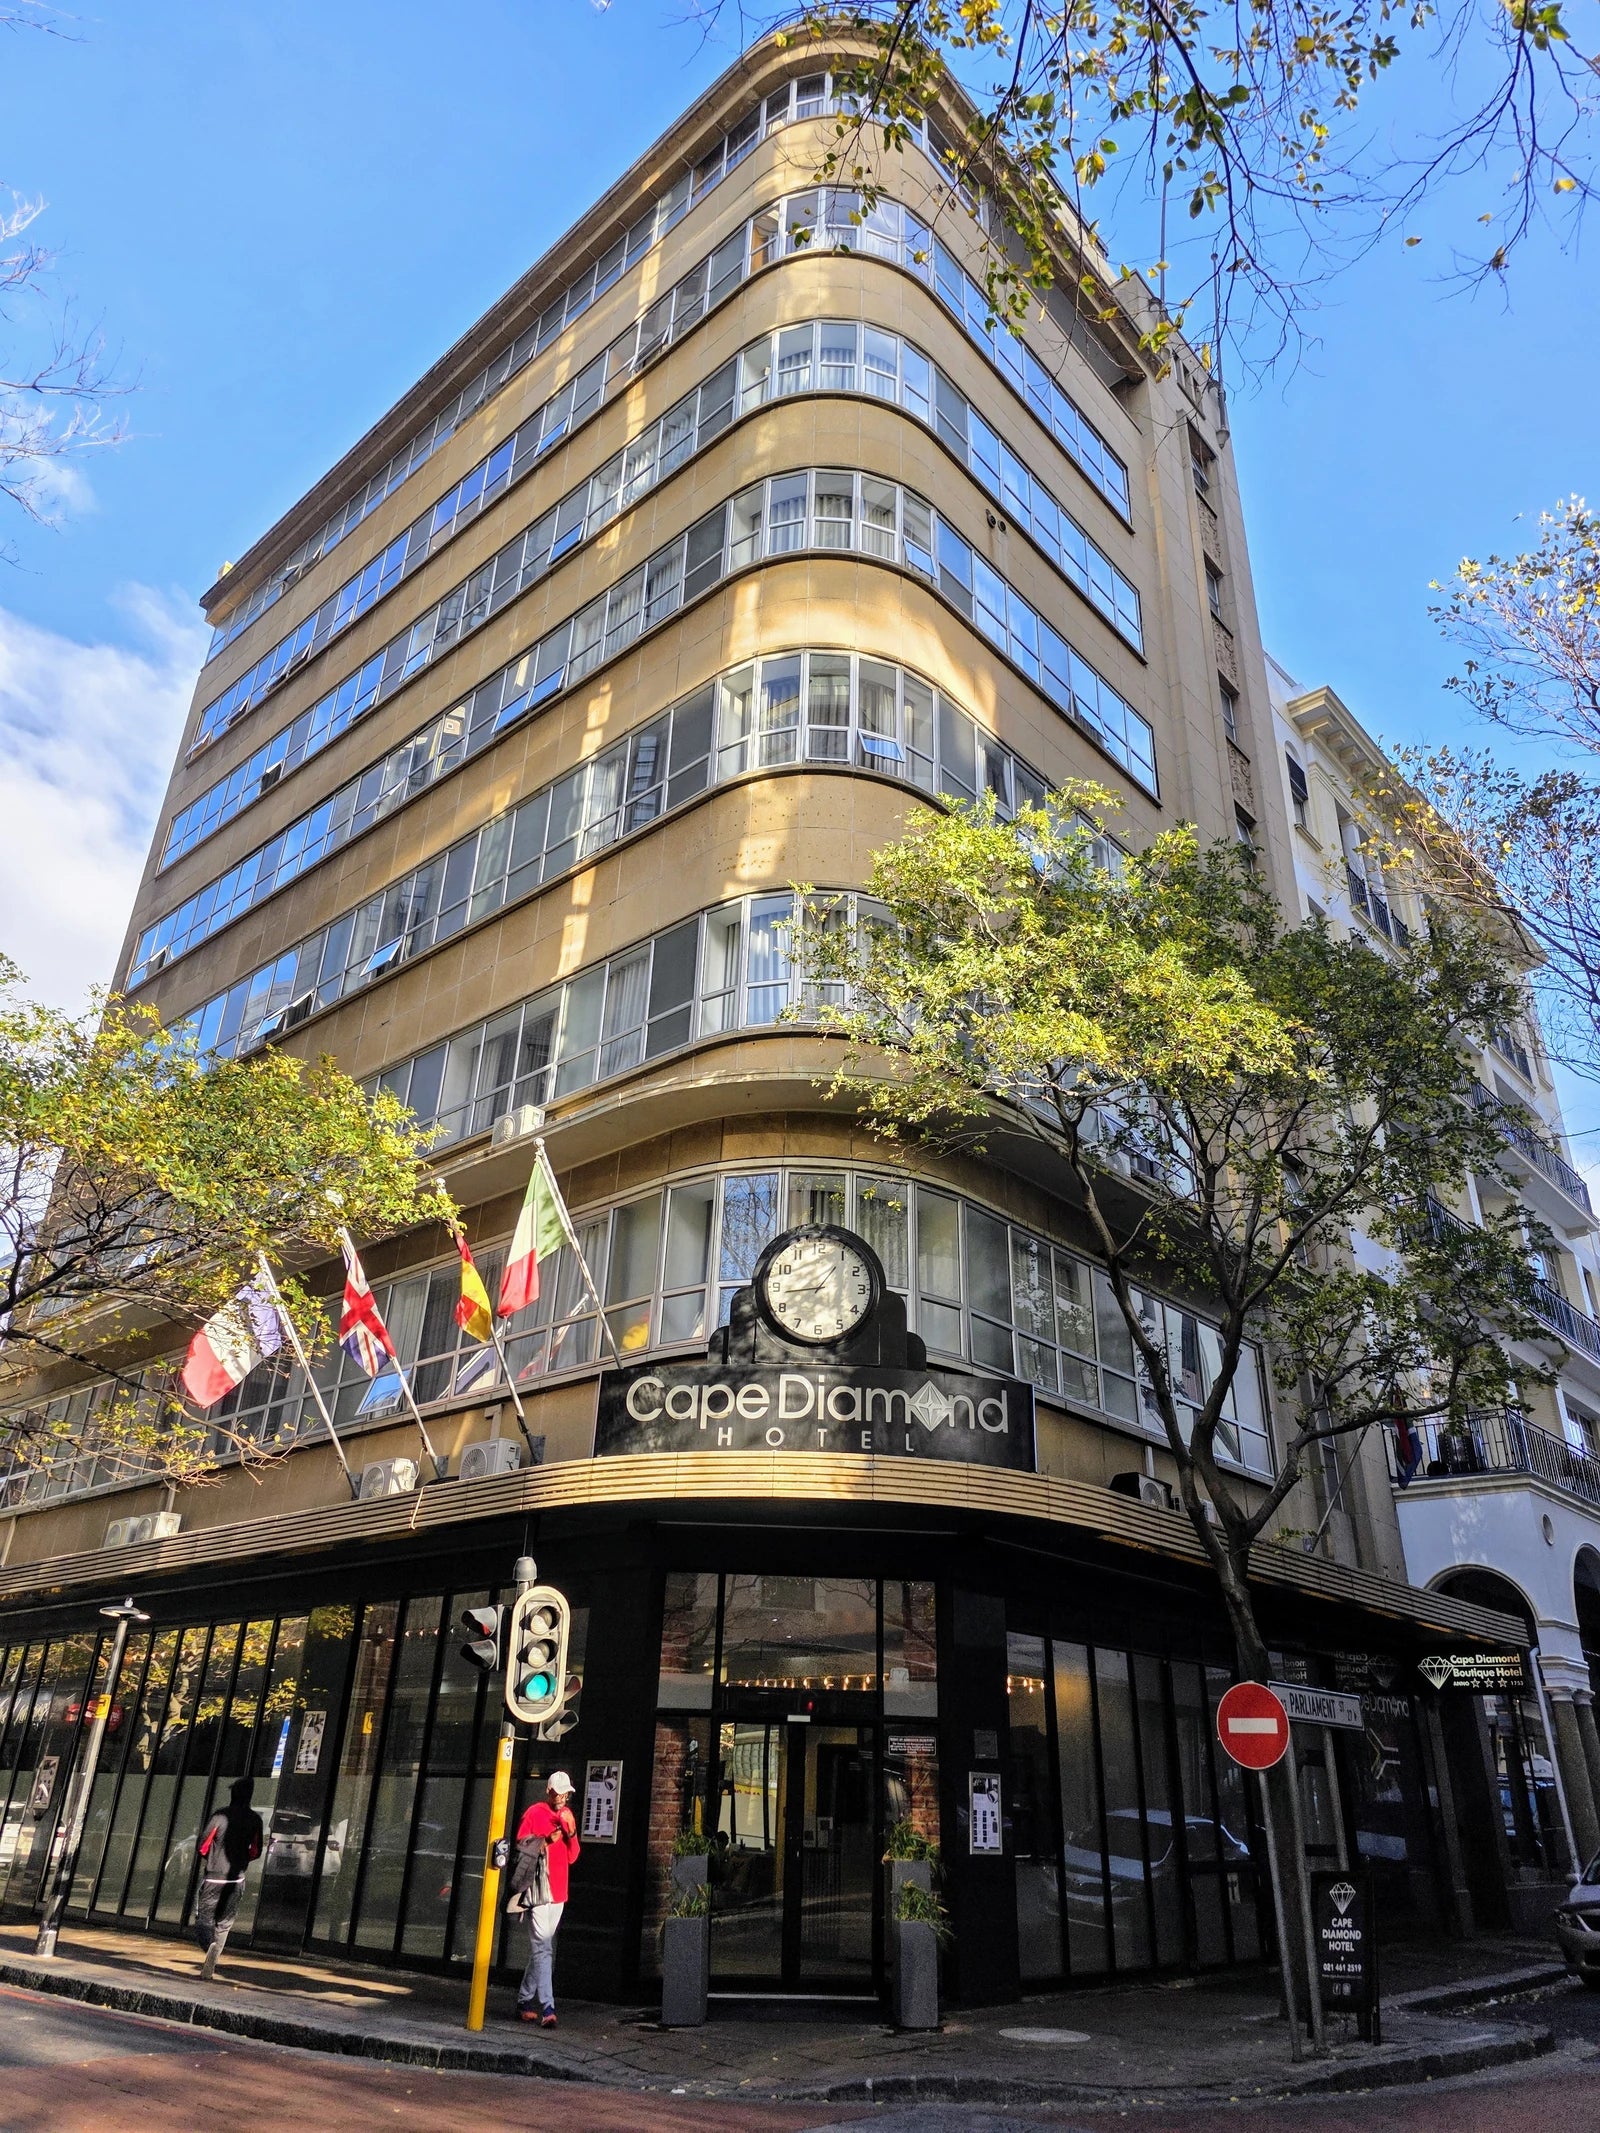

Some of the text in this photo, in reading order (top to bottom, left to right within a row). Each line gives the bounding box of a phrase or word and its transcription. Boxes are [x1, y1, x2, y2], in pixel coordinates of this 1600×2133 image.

[794, 1249, 803, 1261] 11
[813, 1243, 826, 1256] 12
[841, 1250, 845, 1261] 1
[778, 1264, 792, 1275] 10
[852, 1266, 860, 1277] 2
[772, 1282, 781, 1293] 9
[857, 1284, 866, 1295] 3
[778, 1303, 787, 1313] 8
[850, 1304, 859, 1315] 4
[794, 1318, 802, 1328] 7
[836, 1319, 843, 1330] 5
[813, 1325, 823, 1335] 6
[626, 1375, 770, 1430] Cape
[717, 1427, 915, 1453] HOTEL
[1450, 1653, 1521, 1666] Cape Diamond
[1453, 1666, 1523, 1679] Boutique Hotel
[1289, 1692, 1337, 1719] PARLIAMENT
[506, 1745, 511, 1757] 3
[1331, 1918, 1353, 1928] CAPE
[1322, 1929, 1361, 1940] DIAMOND
[1328, 1941, 1355, 1952] HOTEL
